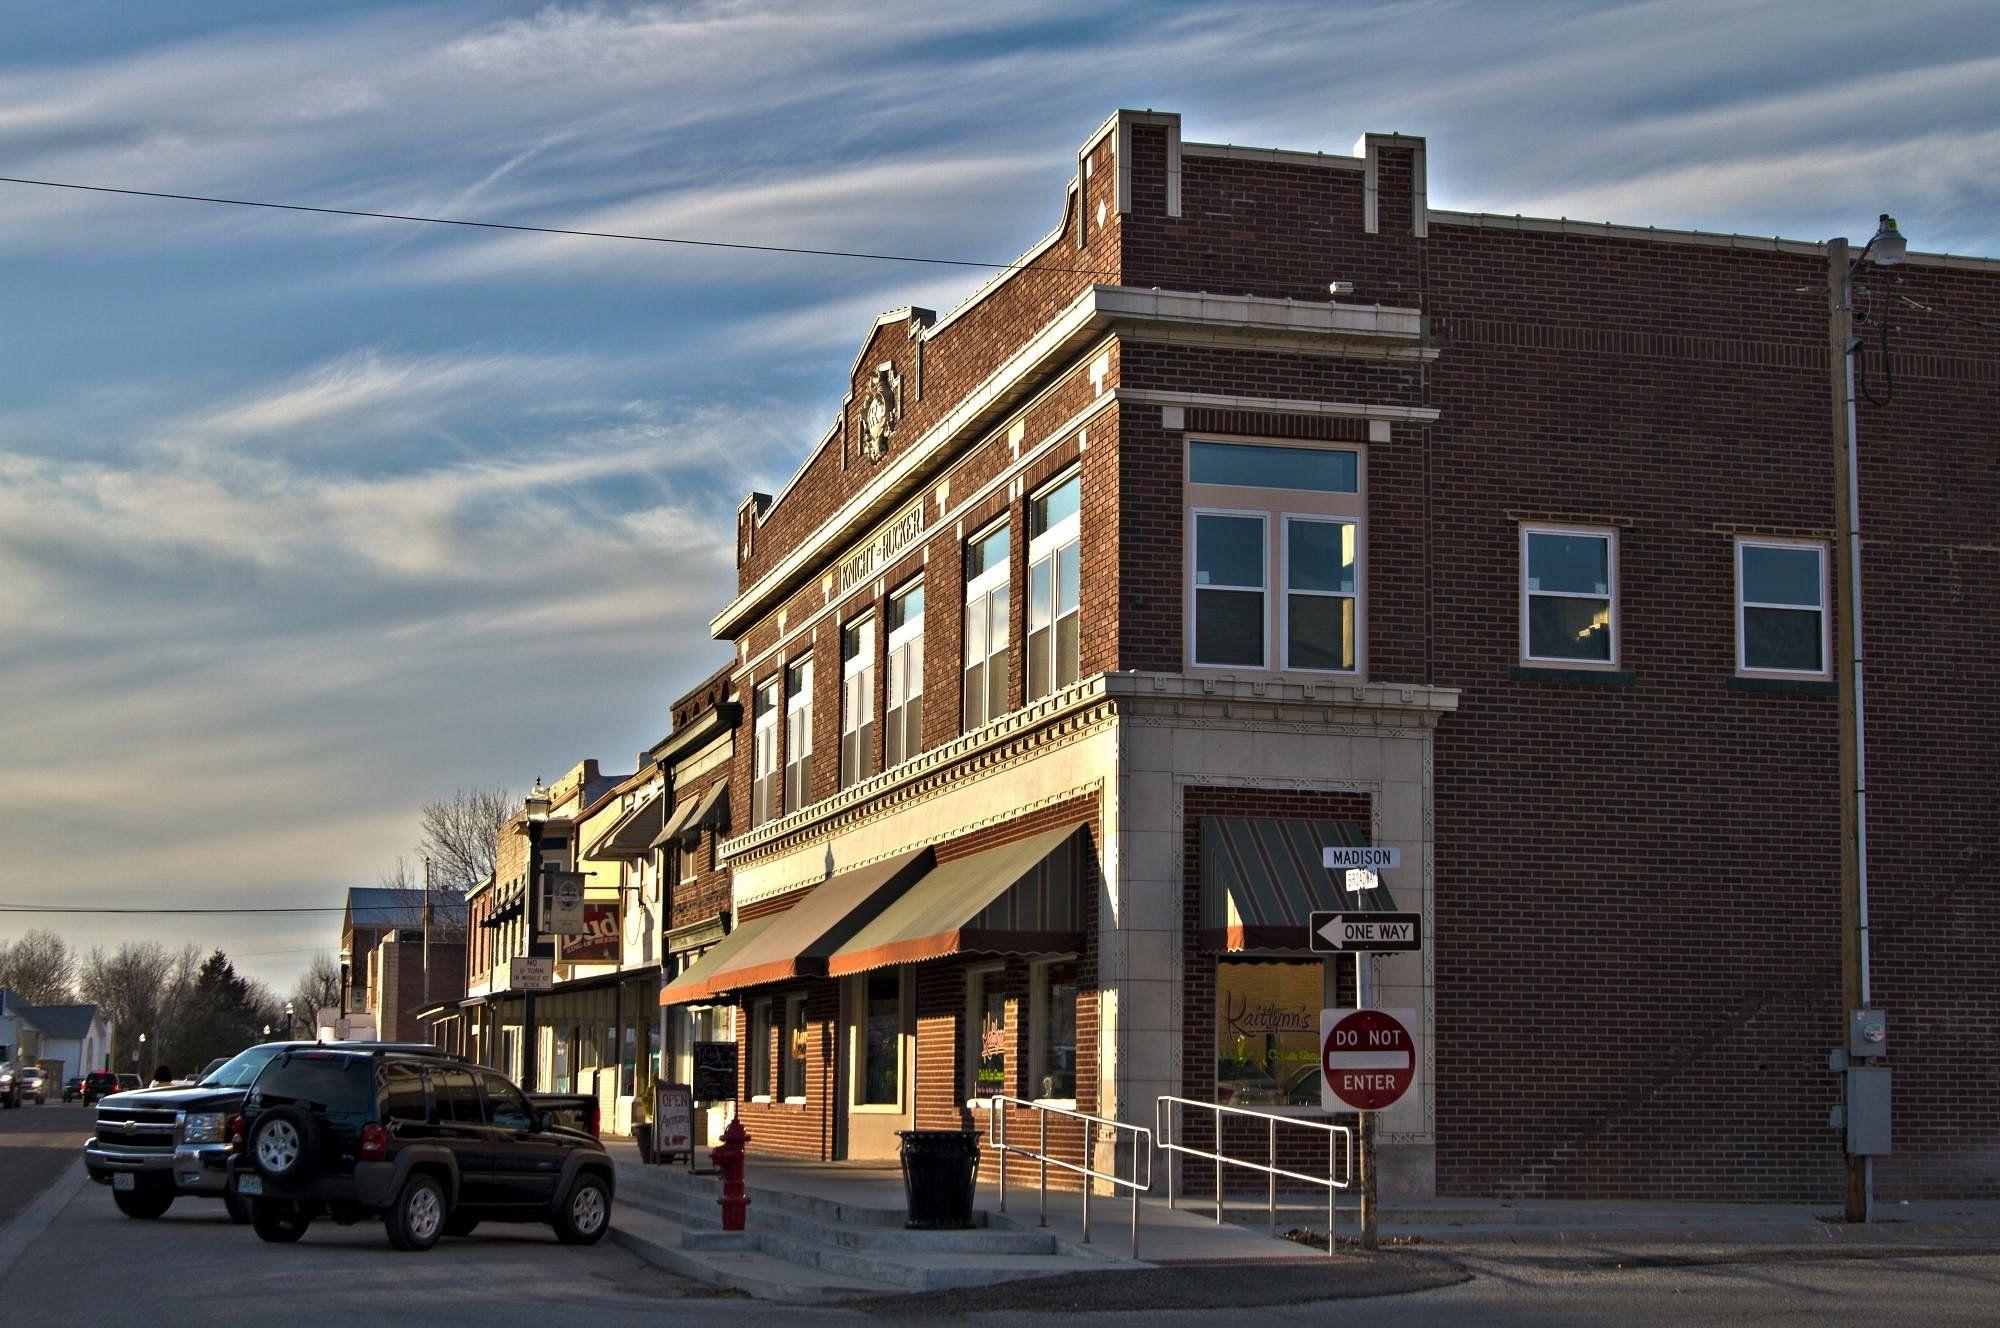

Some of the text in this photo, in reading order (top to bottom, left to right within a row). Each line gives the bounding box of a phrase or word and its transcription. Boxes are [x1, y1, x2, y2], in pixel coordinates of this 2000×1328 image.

[1333, 850, 1391, 865] MADISON
[1344, 924, 1410, 940] ONE WAY
[527, 959, 538, 967] NO
[1336, 1030, 1401, 1046] DO NOT
[1344, 1074, 1396, 1090] ENTER
[662, 1093, 688, 1108] OPEN
